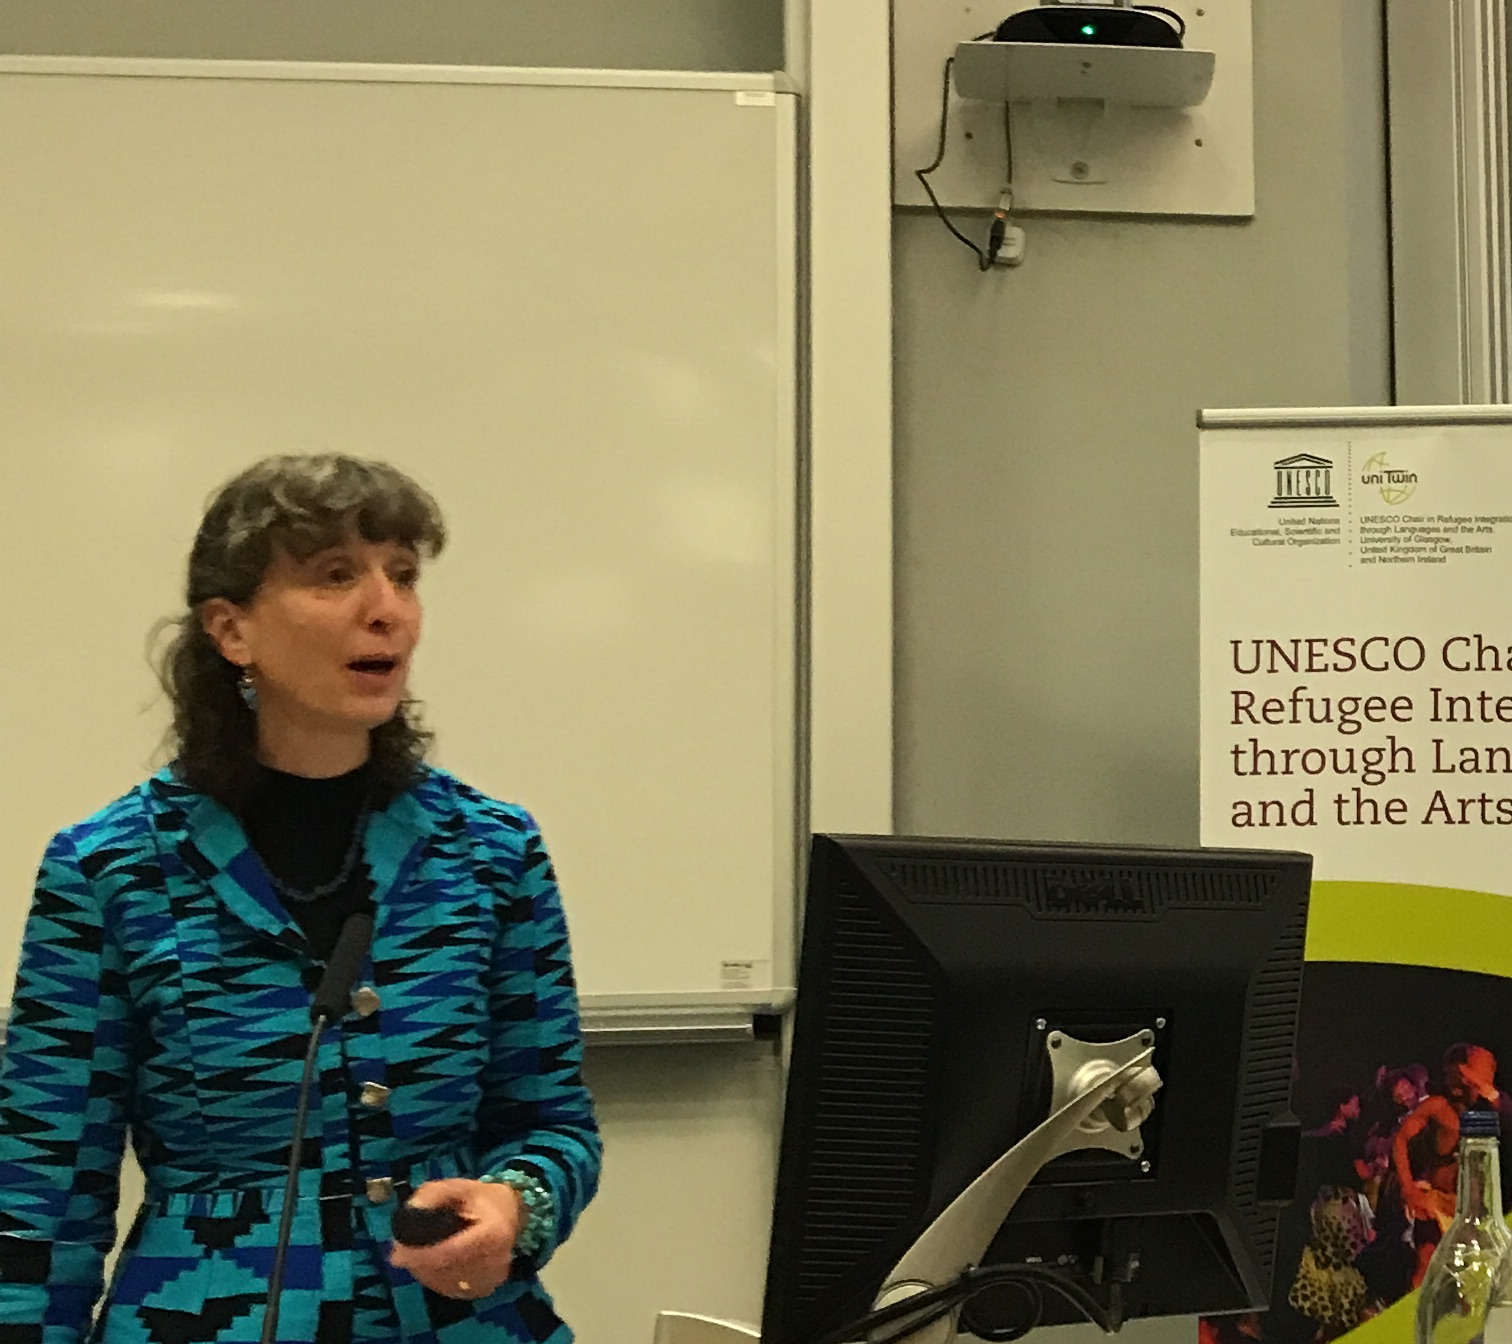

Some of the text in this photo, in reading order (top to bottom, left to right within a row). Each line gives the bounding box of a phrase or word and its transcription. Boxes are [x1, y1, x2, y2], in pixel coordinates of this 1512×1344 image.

[1360, 516, 1400, 524] UNESCO
[1402, 515, 1424, 523] Chair
[1427, 515, 1435, 523] in
[1437, 515, 1472, 525] Refugee
[1360, 526, 1392, 535] through
[1394, 526, 1441, 535] Languages
[1443, 525, 1458, 533] and
[1460, 525, 1474, 533] the
[1360, 536, 1401, 544] University
[1403, 535, 1412, 543] of
[1360, 546, 1387, 554] United
[1390, 546, 1427, 555] Kingdom
[1439, 546, 1463, 554] Great
[1465, 546, 1492, 554] Britain
[1360, 556, 1376, 564] and
[1417, 555, 1446, 563] Ireland
[1230, 635, 1426, 674] UNESCO
[1230, 686, 1414, 735] Refugee
[1230, 736, 1416, 785] through
[1231, 789, 1318, 828] and
[1333, 788, 1409, 826] the
